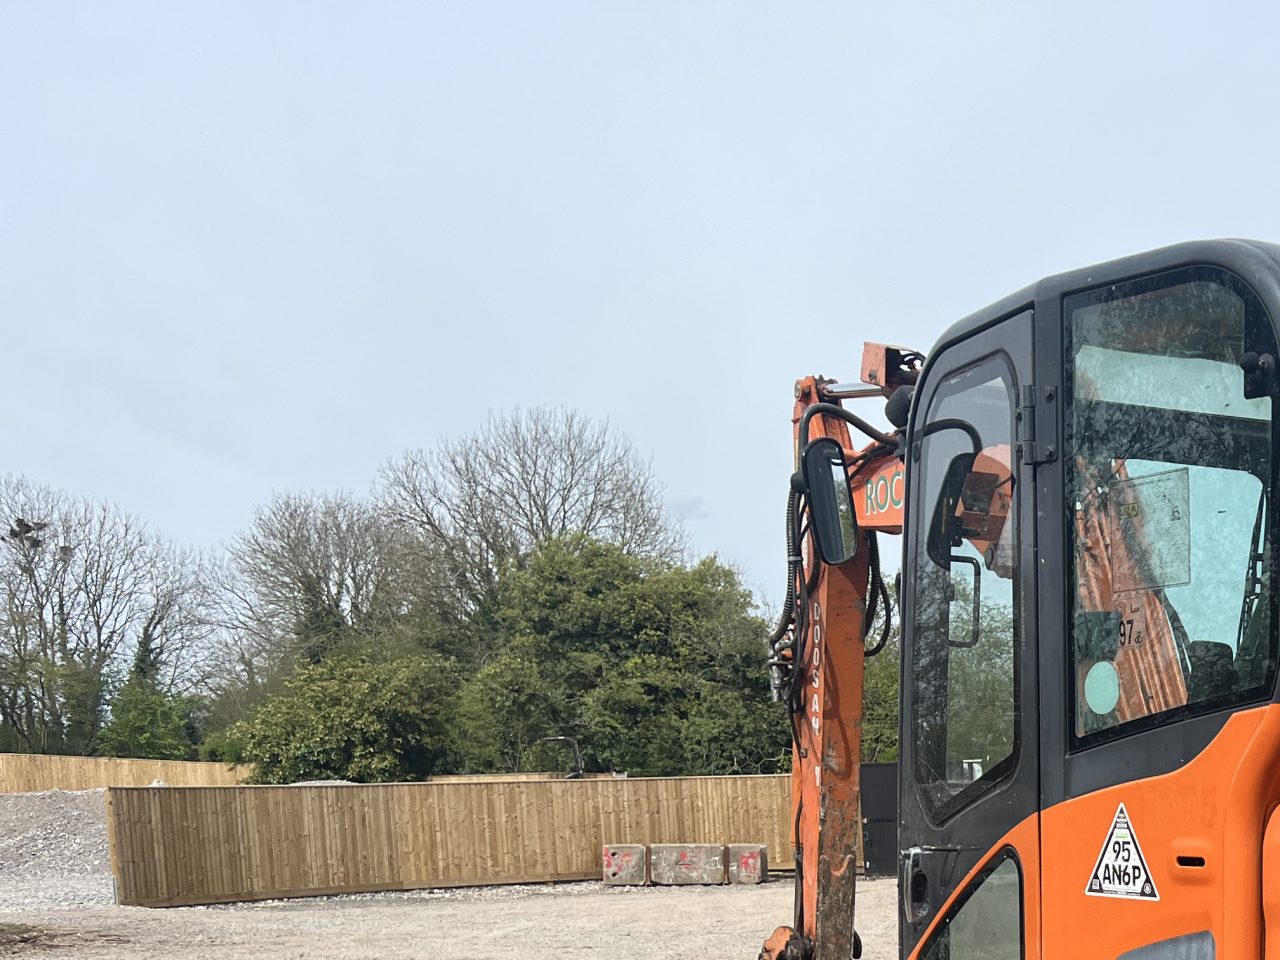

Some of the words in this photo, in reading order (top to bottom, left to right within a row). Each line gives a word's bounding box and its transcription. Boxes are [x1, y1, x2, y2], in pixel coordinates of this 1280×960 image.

[1119, 619, 1134, 646] 97
[811, 602, 822, 736] DOOSAN
[1112, 840, 1131, 862] 95
[1103, 863, 1142, 887] AN6P
